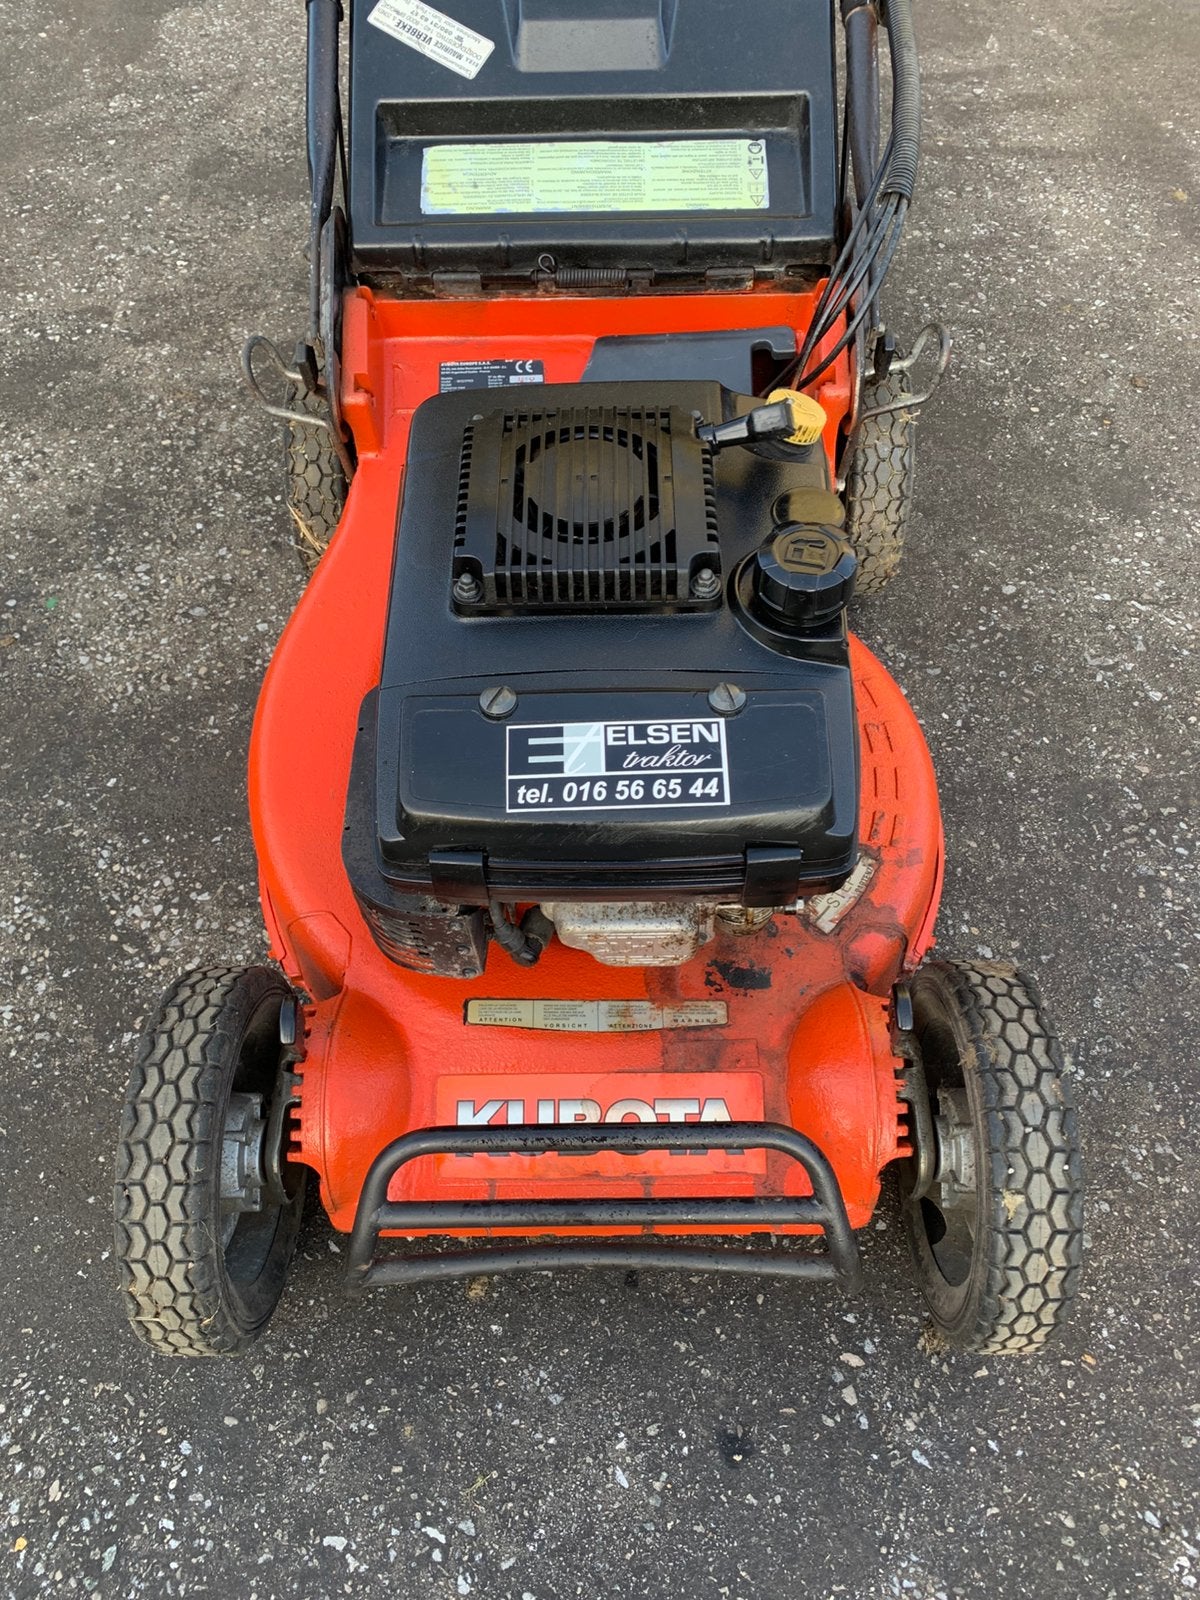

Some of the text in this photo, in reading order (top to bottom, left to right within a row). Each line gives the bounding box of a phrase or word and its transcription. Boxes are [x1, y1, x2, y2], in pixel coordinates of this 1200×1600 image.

[393, 17, 433, 45] VERBEKE
[432, 39, 464, 61] MAURICE
[607, 723, 719, 746] ELSEN
[622, 744, 712, 769] traktor
[517, 777, 719, 804] tel. 016 56 65 44
[456, 1096, 746, 1158] KUBOTA
